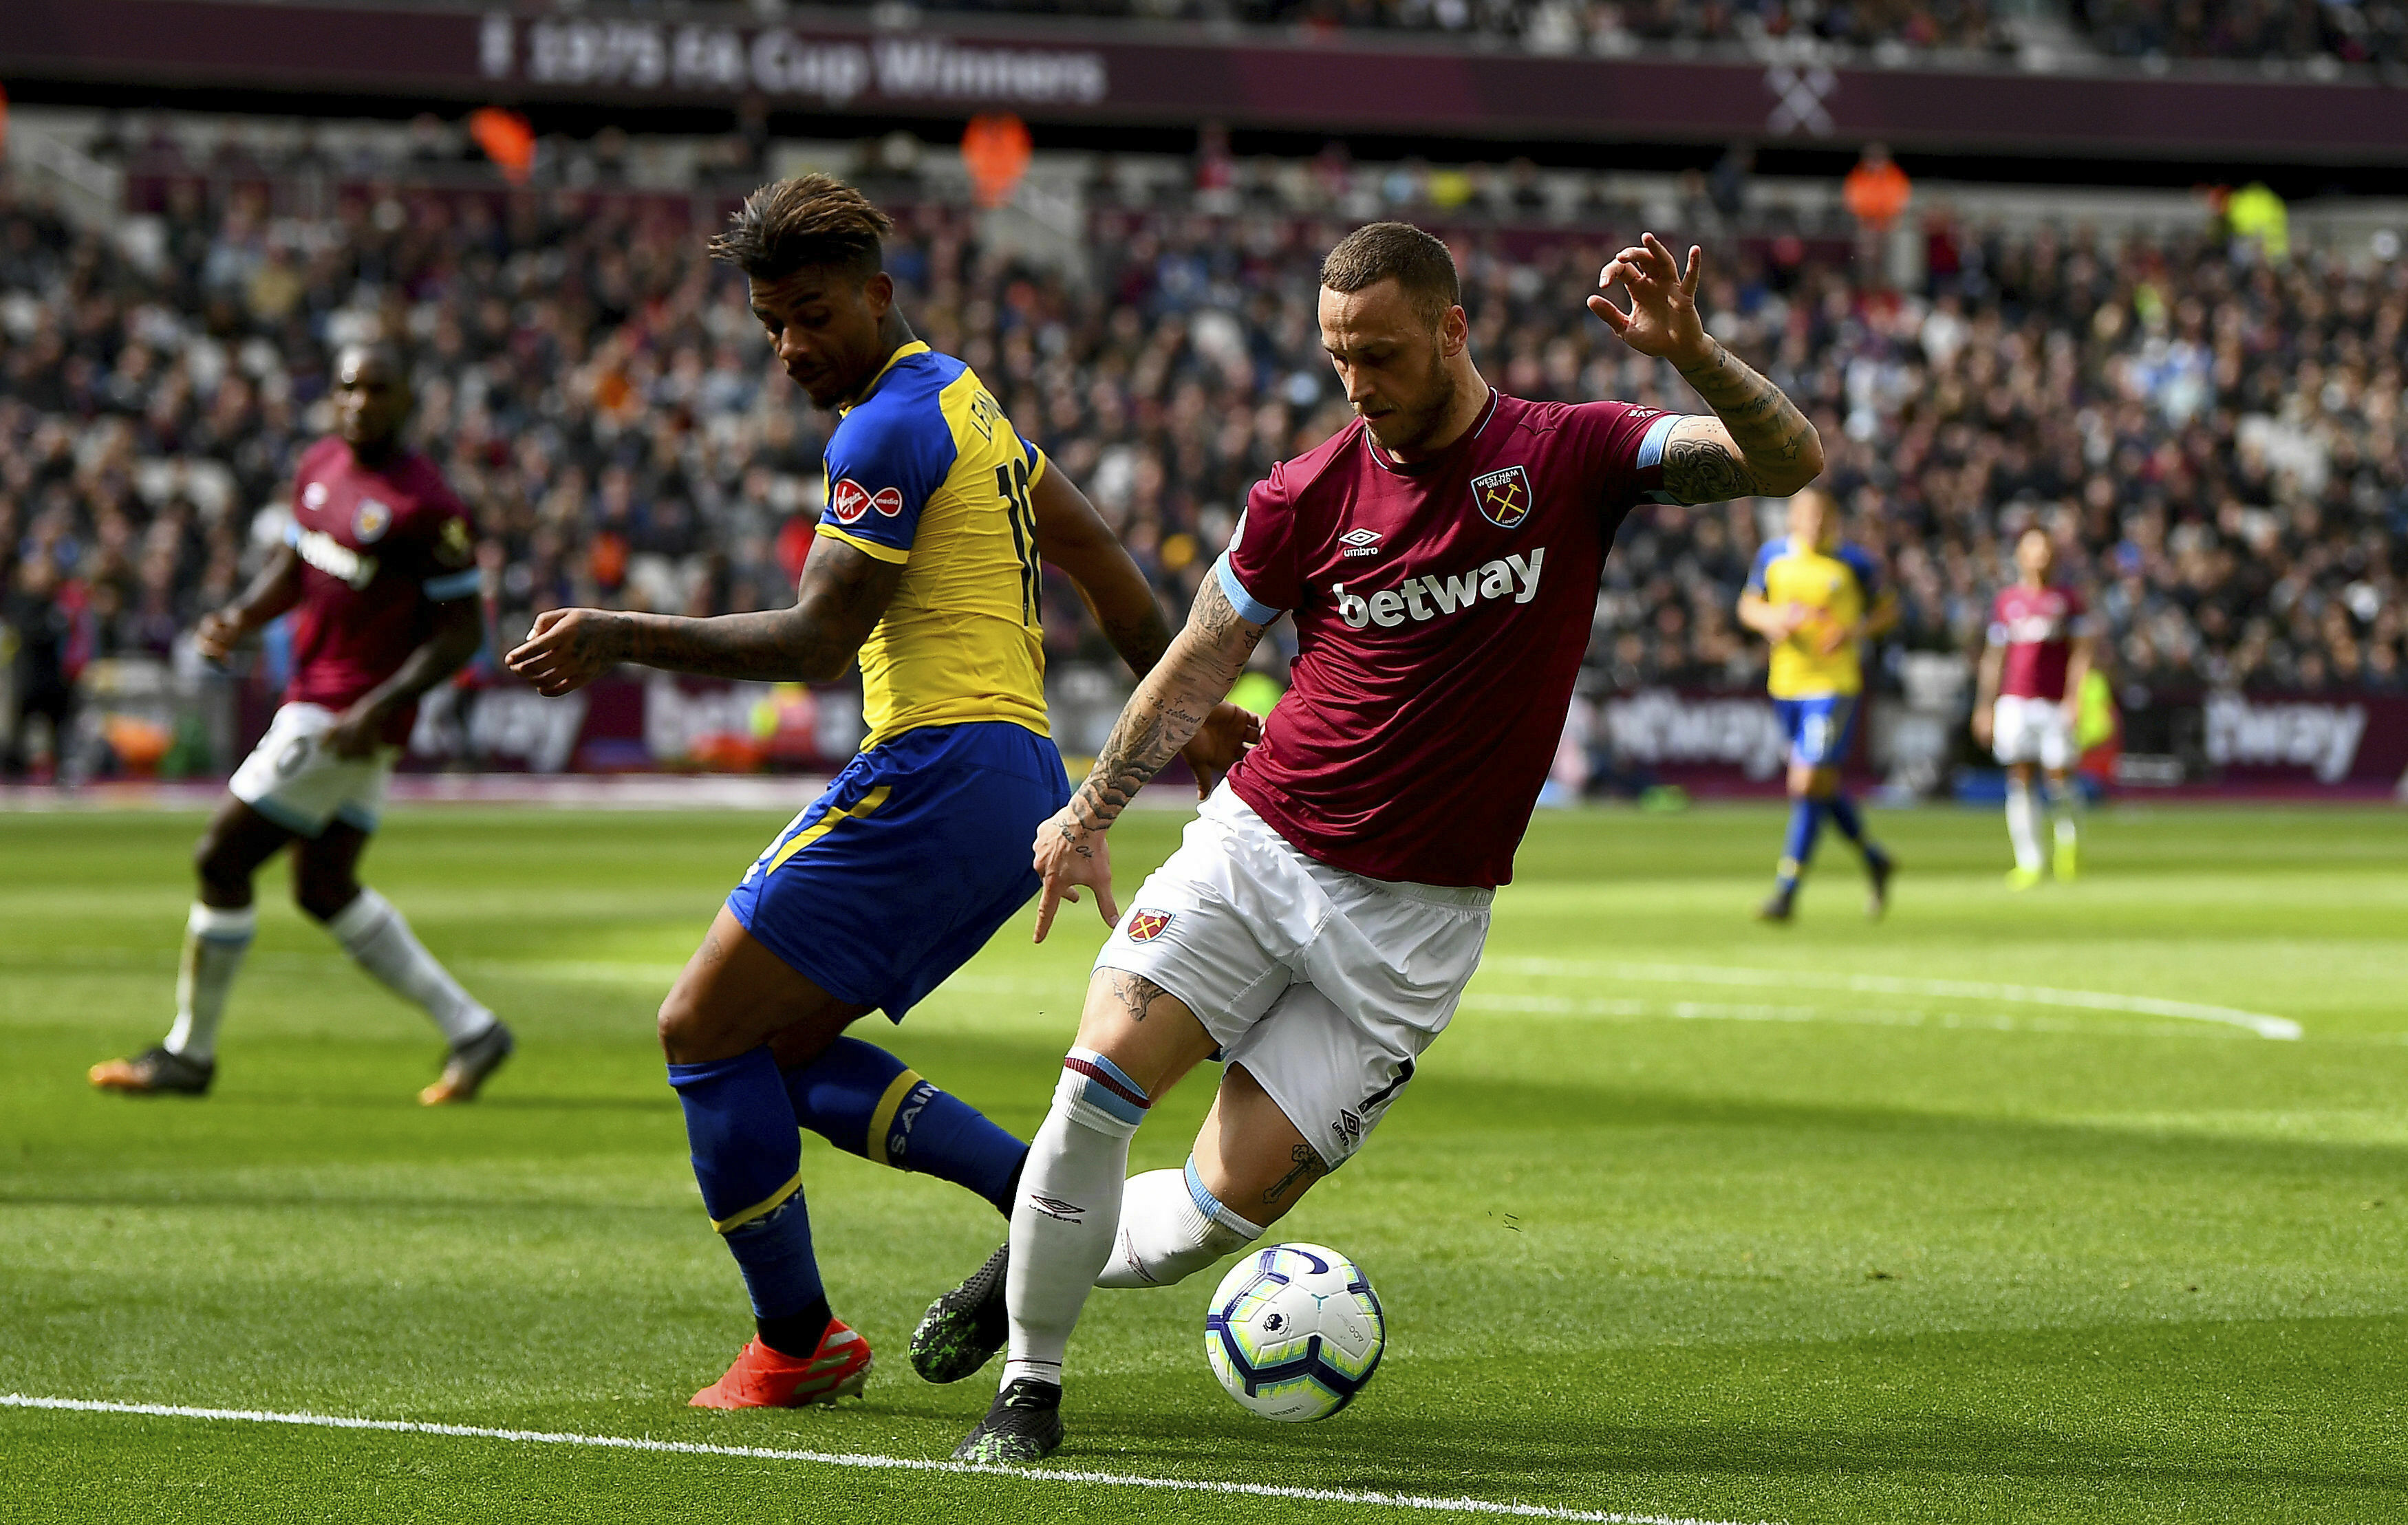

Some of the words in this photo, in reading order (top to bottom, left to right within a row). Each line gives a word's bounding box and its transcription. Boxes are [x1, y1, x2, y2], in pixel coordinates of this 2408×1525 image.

[750, 29, 870, 106] Cup
[872, 37, 1106, 103] Winners
[1476, 475, 1498, 487] WEST
[1498, 469, 1519, 480] HAM
[837, 486, 864, 515] Virgin
[876, 497, 899, 506] media
[1344, 547, 1379, 557] umbro
[1332, 547, 1545, 628] betway
[1332, 1121, 1350, 1147] umbro
